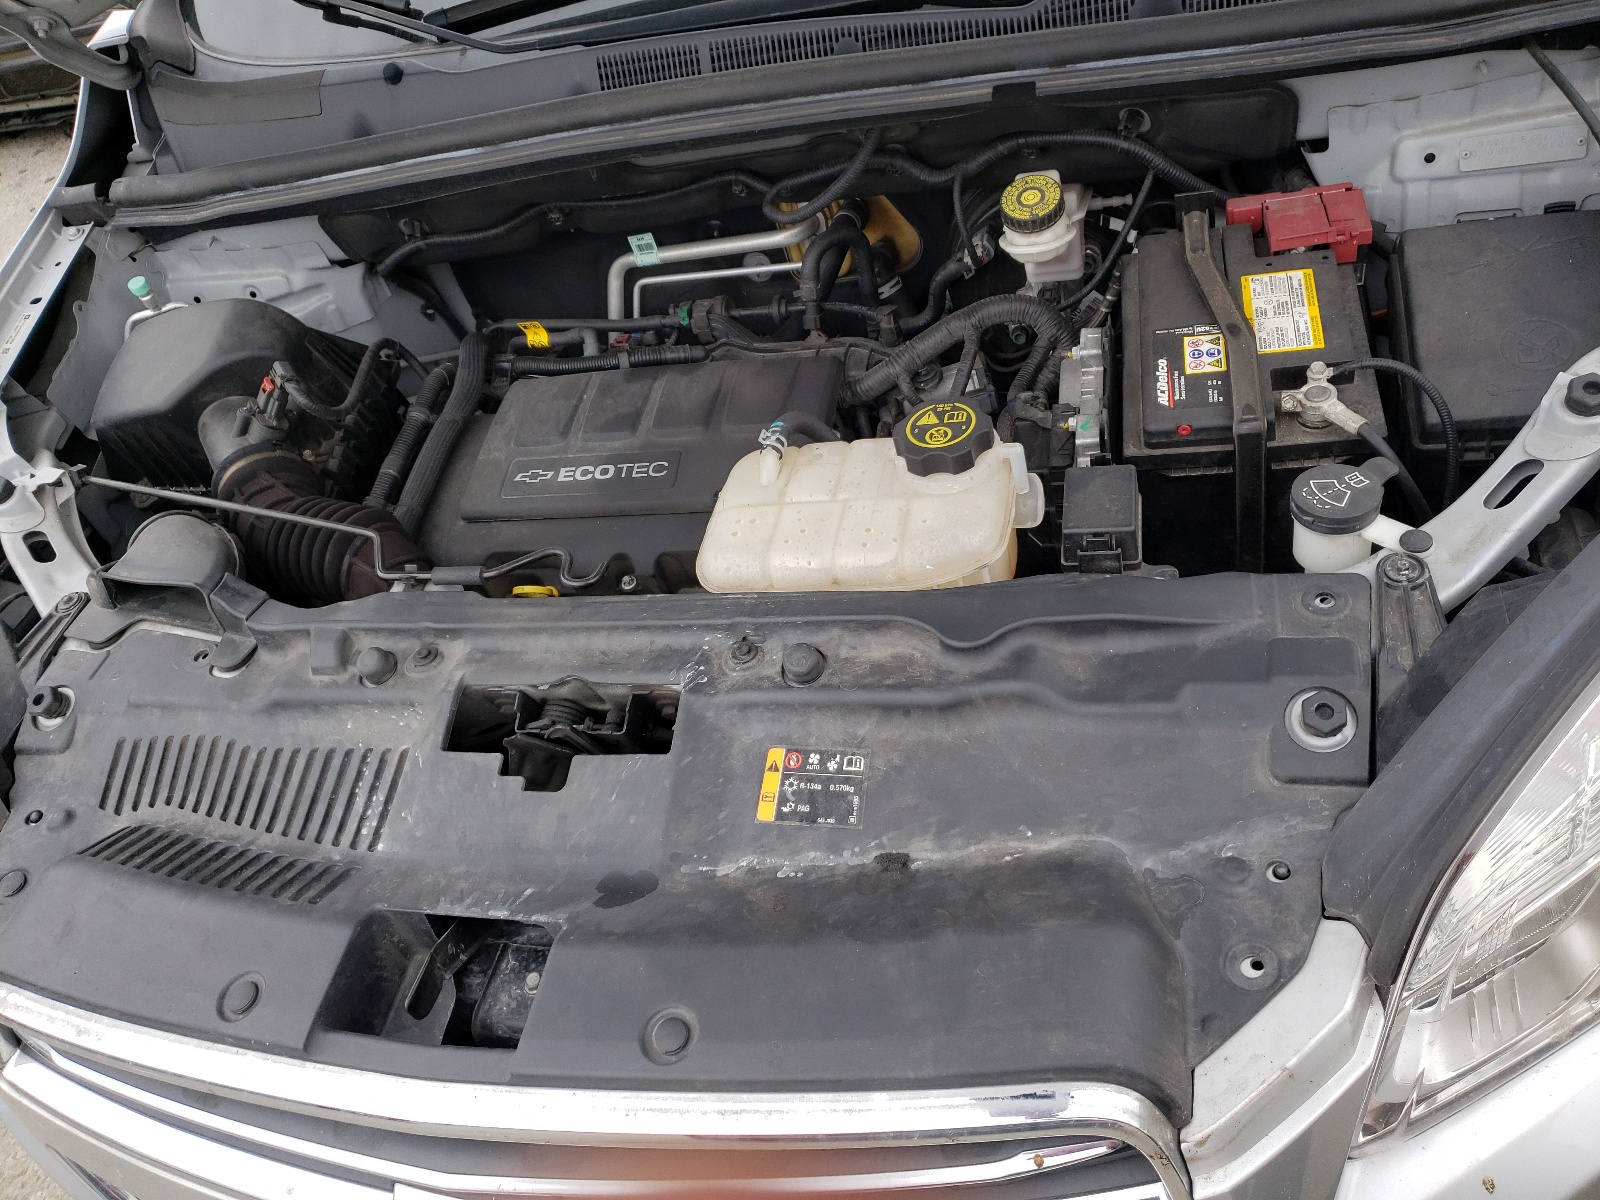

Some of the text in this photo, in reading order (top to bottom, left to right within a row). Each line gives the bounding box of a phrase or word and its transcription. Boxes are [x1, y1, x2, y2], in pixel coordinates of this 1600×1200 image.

[1156, 358, 1169, 407] ACDelco
[557, 461, 669, 482] ECOTEC
[799, 782, 855, 793] R-134a 0.570kg
[797, 804, 810, 812] PAG
